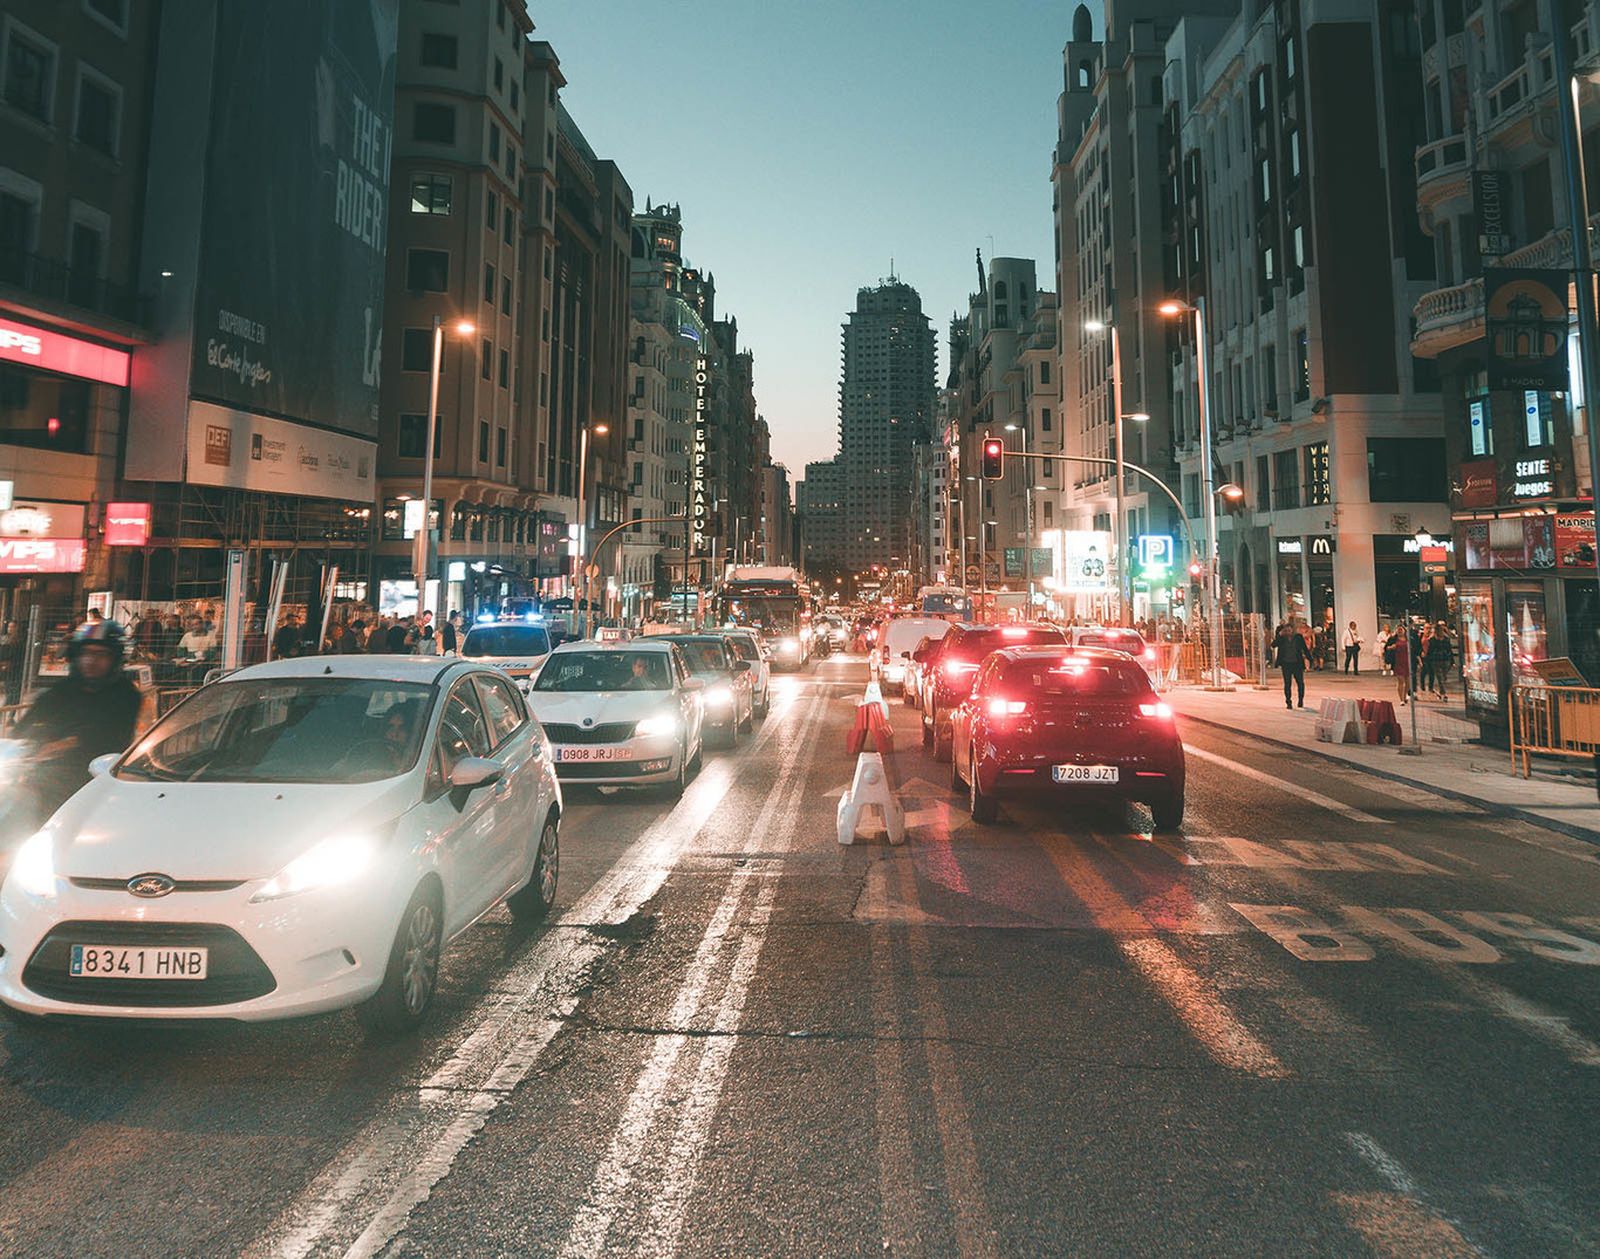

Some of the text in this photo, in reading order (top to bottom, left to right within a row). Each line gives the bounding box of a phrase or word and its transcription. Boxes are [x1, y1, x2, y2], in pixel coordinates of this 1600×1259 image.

[353, 93, 382, 178] THE
[336, 158, 382, 252] RIDER
[1481, 173, 1501, 236] EXCELSIOR
[0, 329, 41, 355] IPS
[694, 359, 707, 543] HOTEL EMPERADOR
[1514, 481, 1551, 496] Juegos
[1557, 518, 1595, 527] MADRID
[0, 541, 55, 559] VIPS
[603, 631, 620, 640] TAXI
[563, 749, 589, 760] 0908
[593, 749, 613, 760] JRJ
[1060, 767, 1117, 780] 7208 JZT
[85, 949, 202, 975] 8341 HNB
